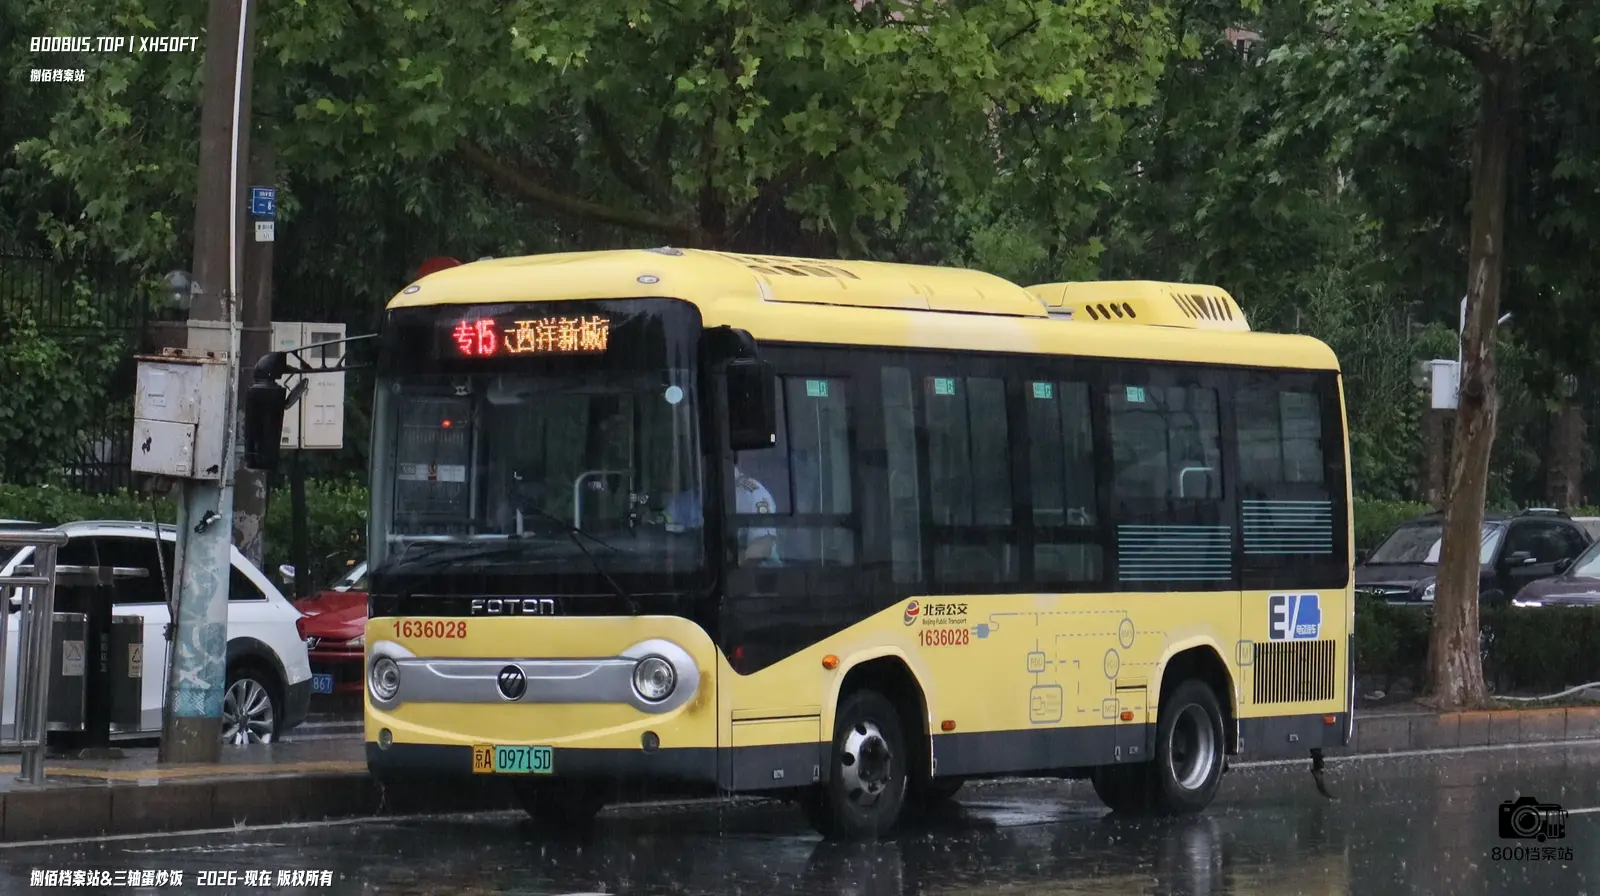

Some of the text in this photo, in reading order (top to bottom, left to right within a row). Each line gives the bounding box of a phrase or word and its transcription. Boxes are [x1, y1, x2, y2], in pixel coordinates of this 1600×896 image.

[453, 318, 496, 354] 专15
[471, 599, 554, 614] FOTON
[923, 603, 968, 616] 北京公交
[393, 620, 467, 638] 1636028
[922, 618, 936, 627] Beijing
[948, 618, 967, 626] Transport
[918, 629, 969, 646] 1636028
[313, 676, 330, 690] 867
[475, 749, 551, 769] 京A 09715D
